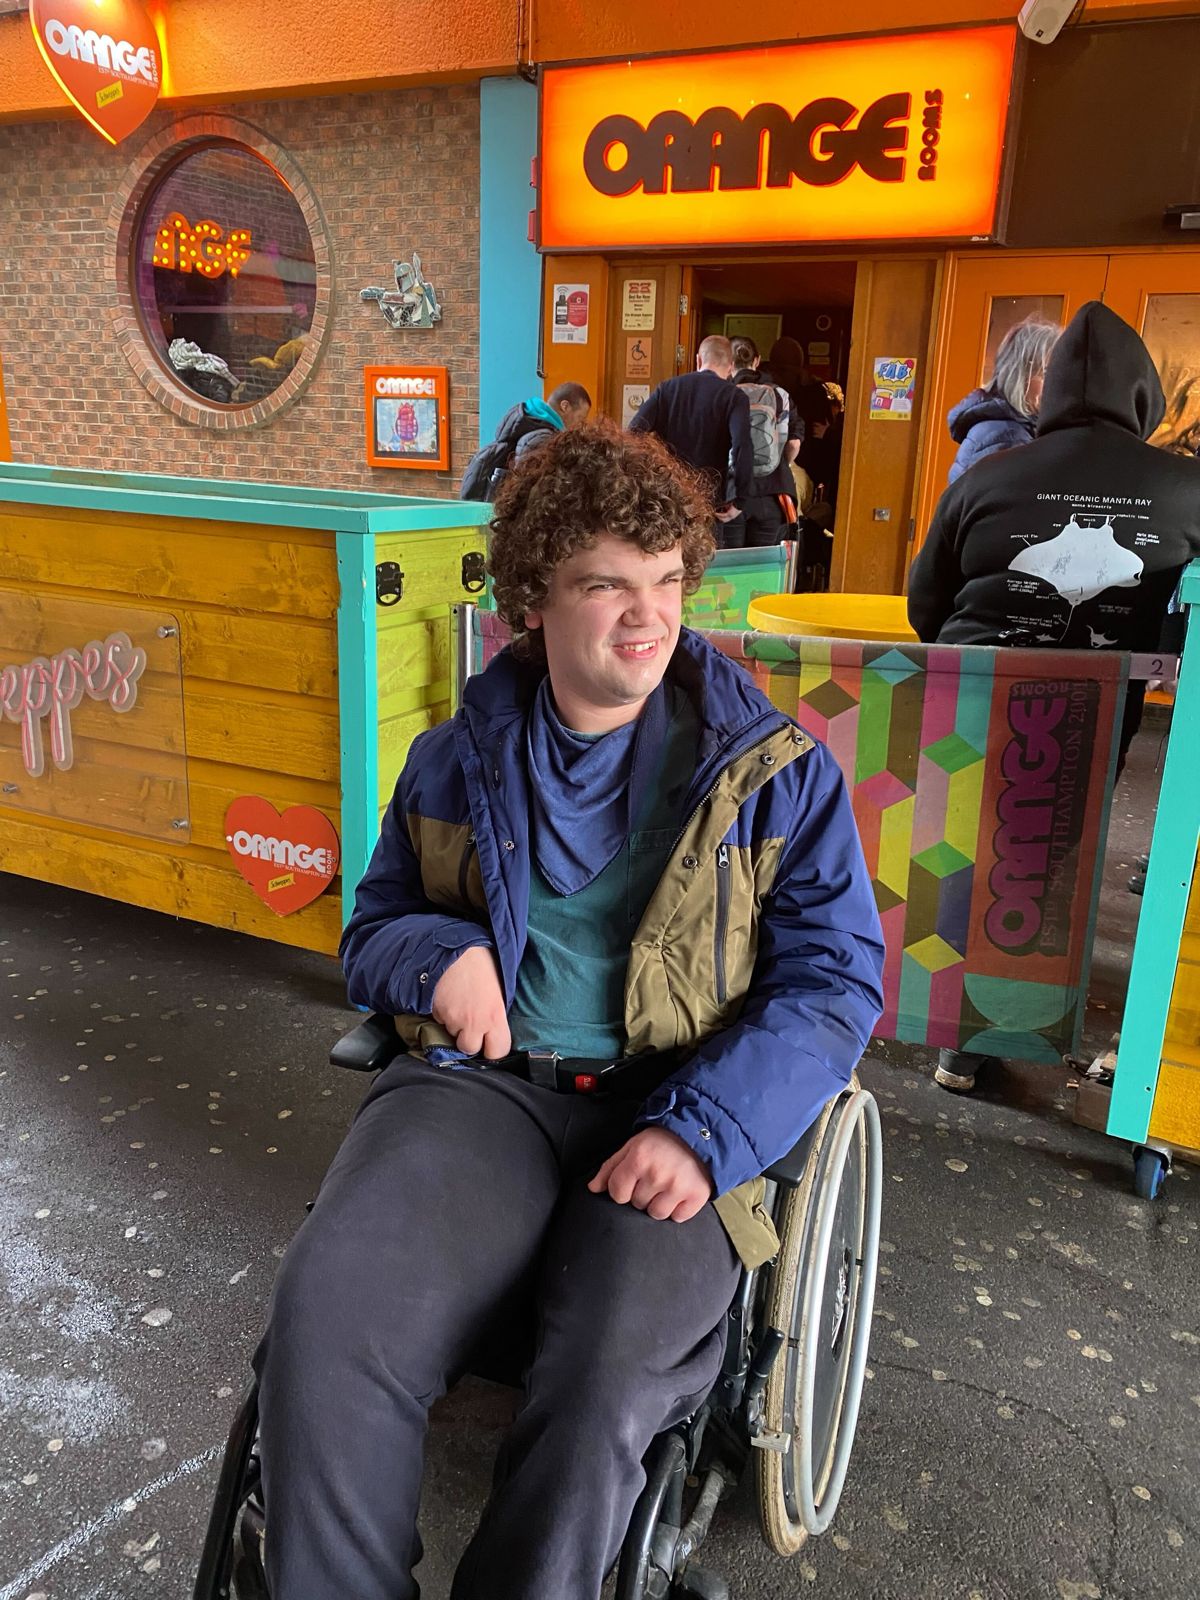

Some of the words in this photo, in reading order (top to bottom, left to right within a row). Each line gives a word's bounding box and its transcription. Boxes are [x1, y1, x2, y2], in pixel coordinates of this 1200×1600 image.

[45, 19, 153, 81] ORANGE
[583, 92, 911, 198] ORANGE
[918, 88, 943, 181] ROOMS
[376, 377, 433, 395] ORANGE
[1037, 493, 1061, 501] GIANT
[1063, 494, 1100, 503] OCEANIC
[1102, 496, 1132, 505] MANTA
[1135, 498, 1152, 506] RAY
[1010, 682, 1070, 697] ROOMS
[1151, 659, 1164, 675] 2
[1047, 730, 1083, 892] SOUTHAMPTON
[1069, 682, 1089, 724] 2001
[985, 697, 1067, 948] ORANGE
[233, 830, 326, 874] ORANGE
